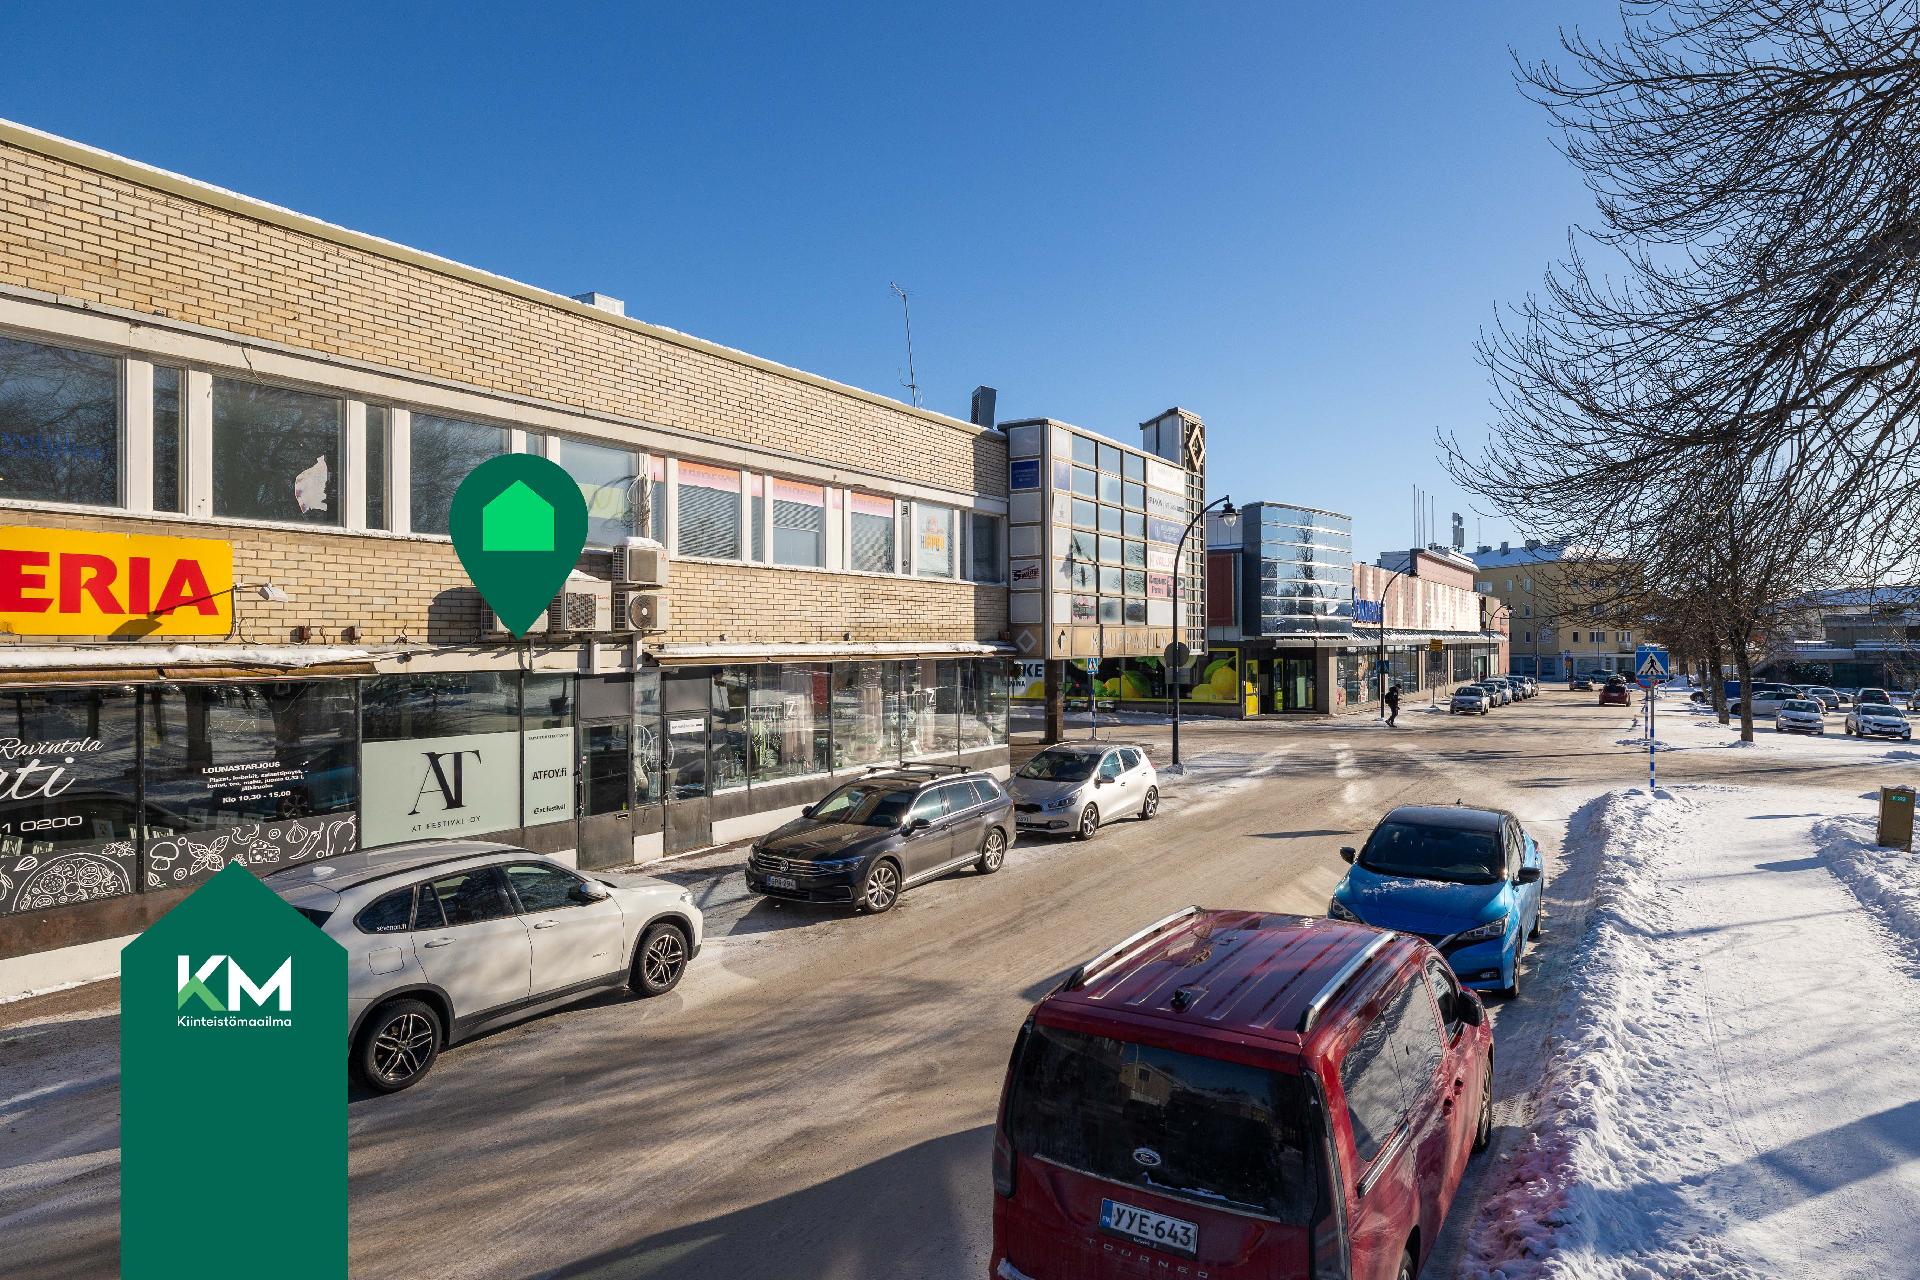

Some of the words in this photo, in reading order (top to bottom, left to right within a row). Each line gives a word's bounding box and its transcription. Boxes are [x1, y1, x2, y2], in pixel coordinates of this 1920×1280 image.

[0, 550, 219, 615] ERIA
[0, 736, 105, 760] Ravintola
[202, 761, 281, 774] LOUNASTARJOUS
[532, 767, 567, 781] ATFOY.fi
[407, 749, 482, 816] AT
[20, 815, 83, 832] 0200
[411, 824, 422, 832] AT
[426, 818, 464, 830] FESTIVAL
[1115, 1207, 1192, 1247] YYE-643
[1087, 1238, 1209, 1279] TOURNEO
